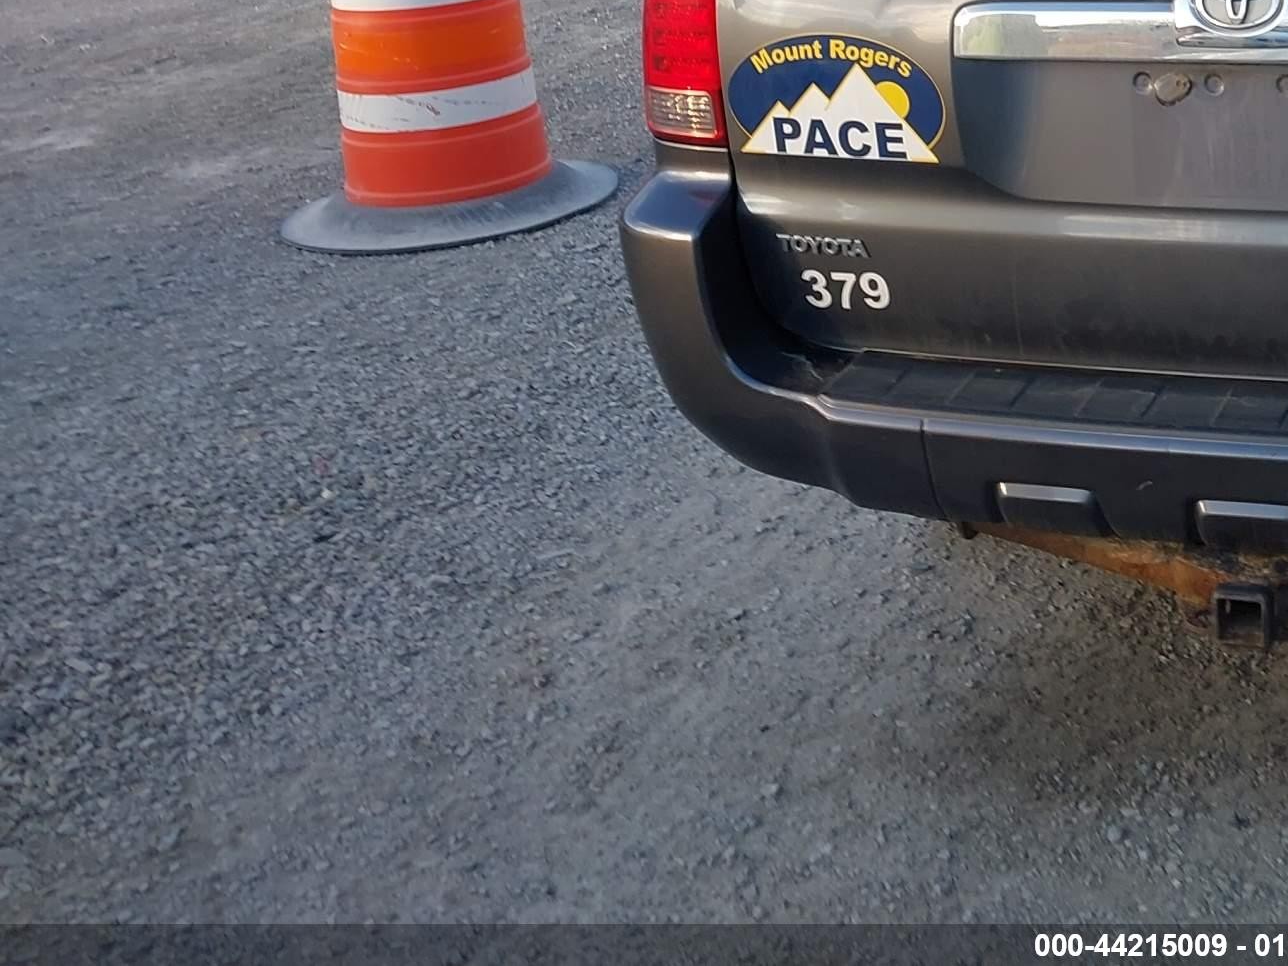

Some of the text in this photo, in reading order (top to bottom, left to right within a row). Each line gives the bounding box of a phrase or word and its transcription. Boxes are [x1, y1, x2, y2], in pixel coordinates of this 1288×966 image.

[750, 38, 912, 78] Mount Rogers
[773, 117, 908, 159] PACE
[776, 233, 872, 258] TOYOTA
[801, 269, 891, 309] 379
